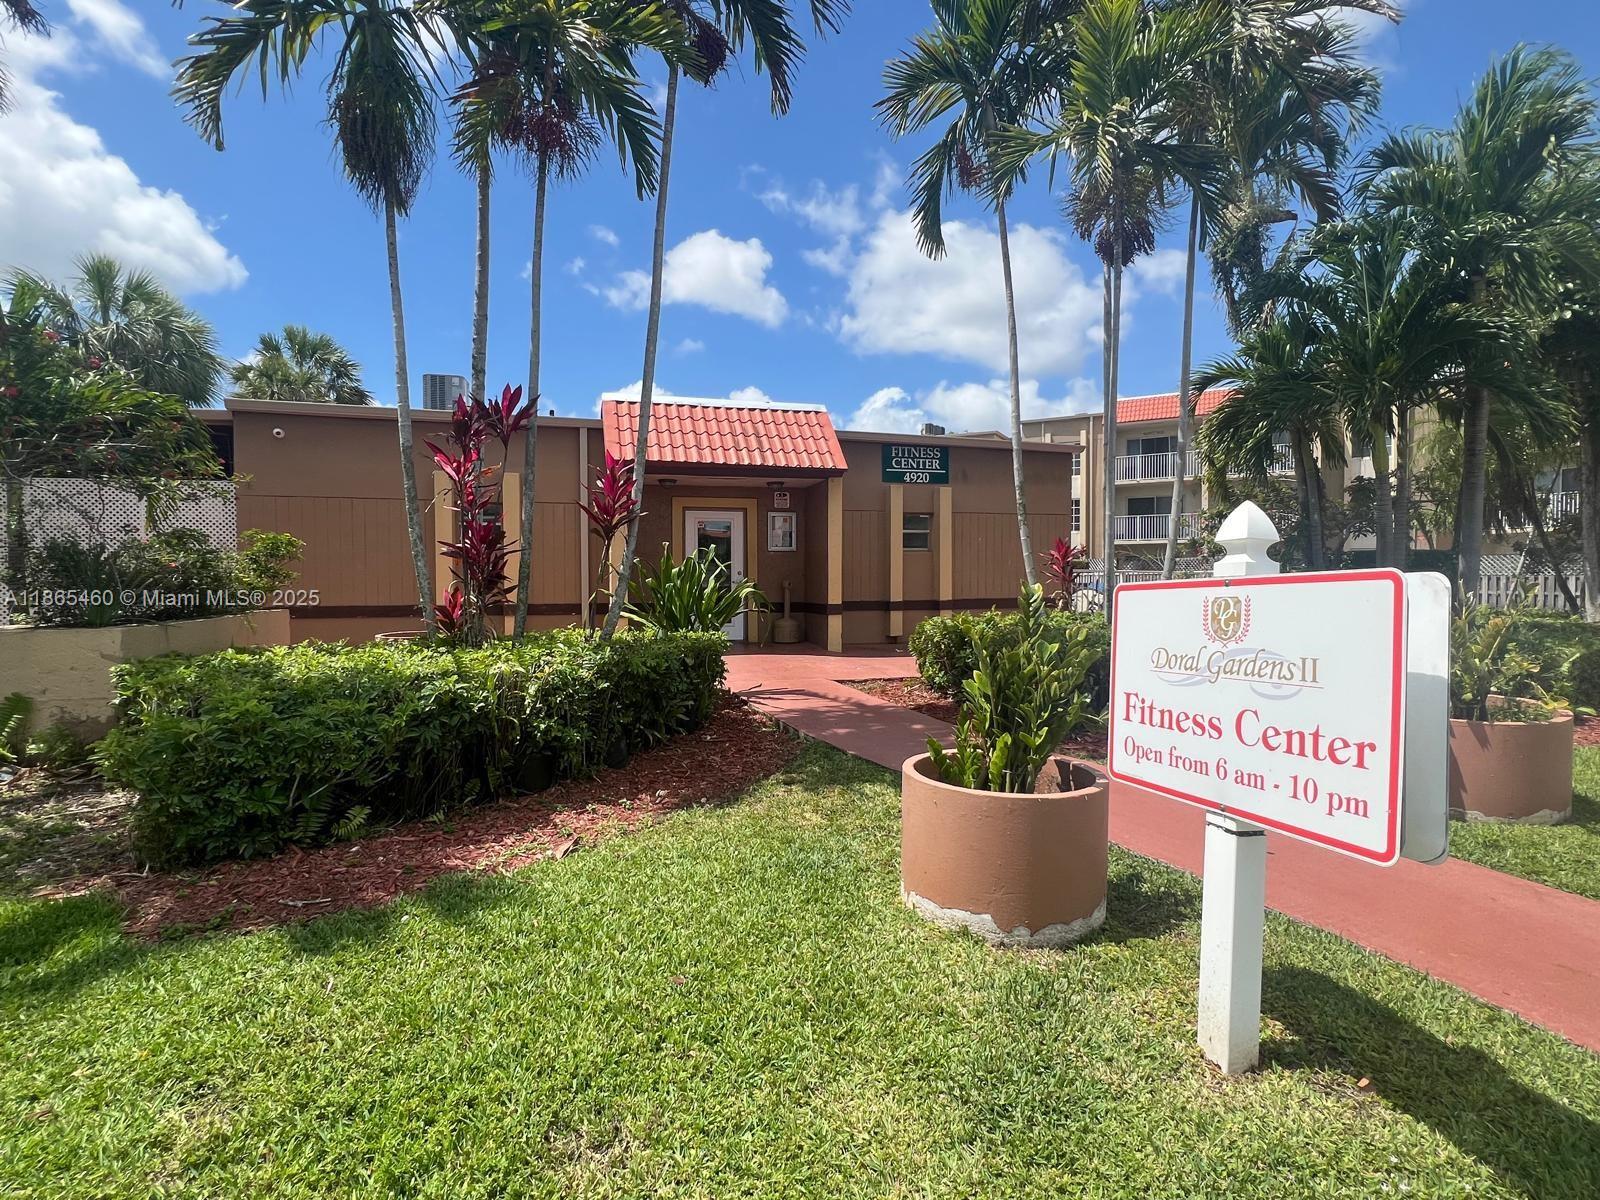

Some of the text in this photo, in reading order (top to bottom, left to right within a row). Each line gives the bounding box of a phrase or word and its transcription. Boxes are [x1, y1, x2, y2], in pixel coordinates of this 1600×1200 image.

[891, 446, 941, 458] FITNESS
[892, 458, 941, 469] CENTER
[903, 472, 930, 483] 4920
[1150, 645, 1321, 684] Doral Gardens II
[1121, 691, 1378, 771] Fitness Center
[1123, 735, 1164, 765] Open
[1167, 746, 1210, 777] from
[1215, 758, 1229, 781] 6
[1233, 767, 1267, 792] am
[1288, 775, 1319, 805] 10
[1326, 790, 1371, 819] pm
